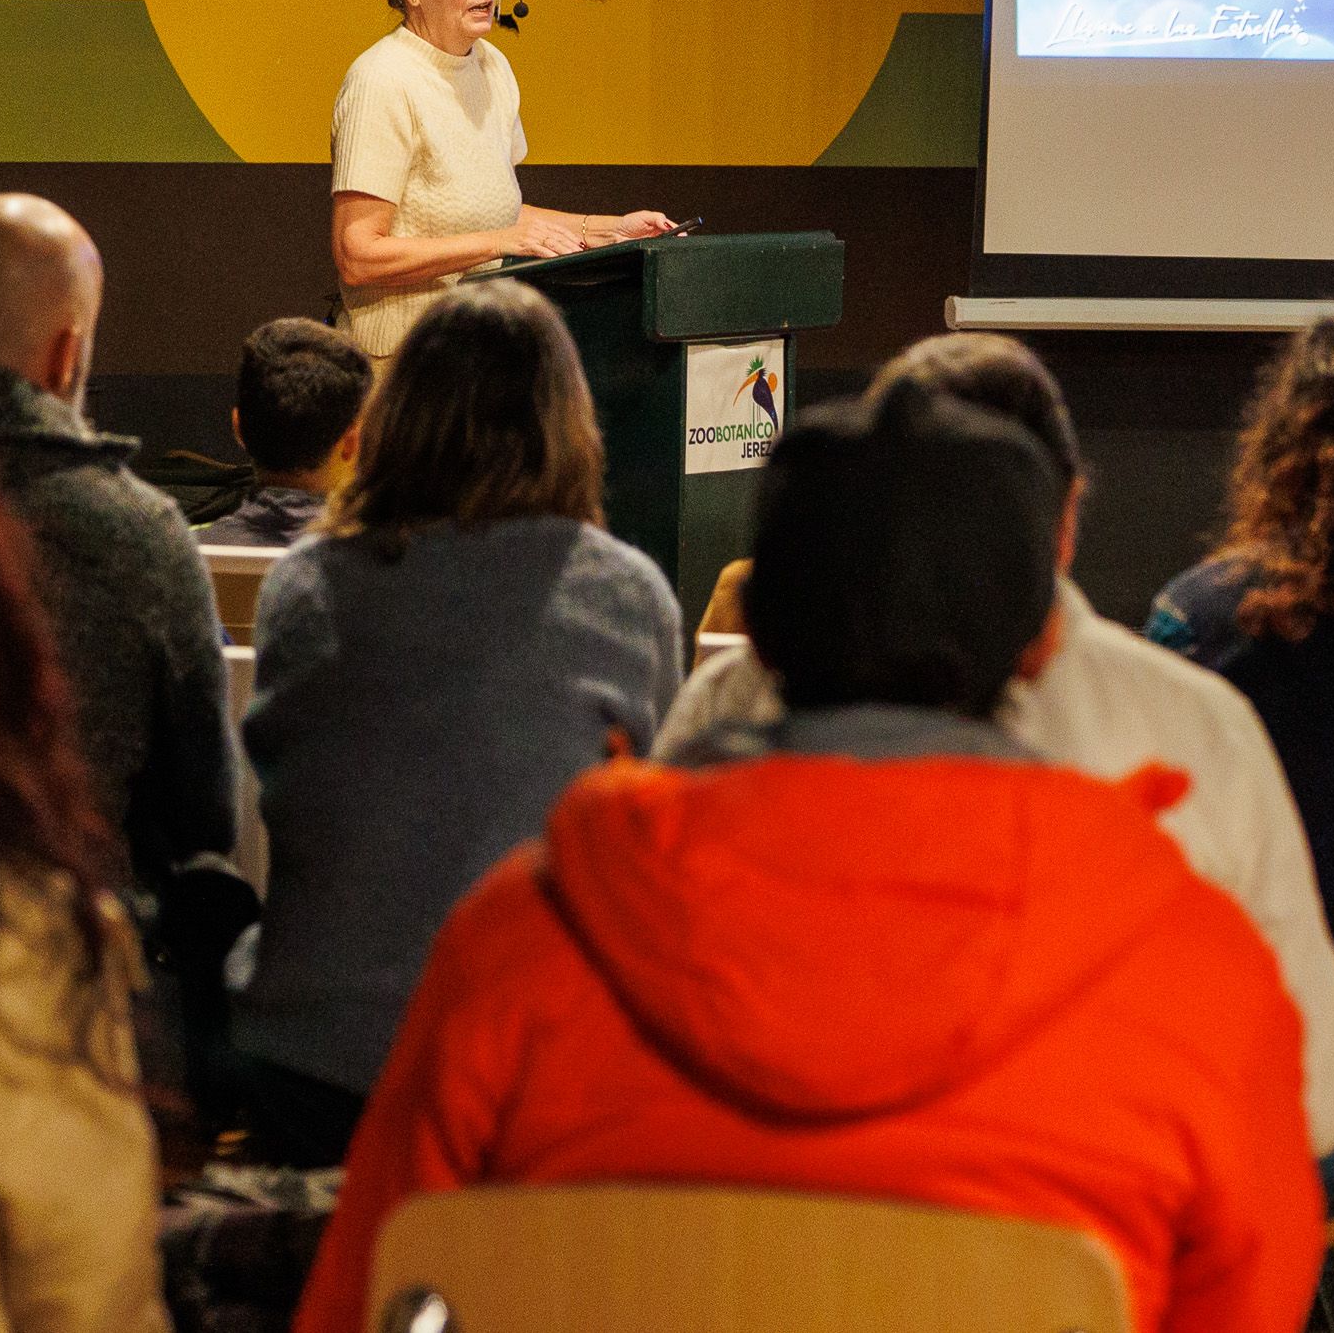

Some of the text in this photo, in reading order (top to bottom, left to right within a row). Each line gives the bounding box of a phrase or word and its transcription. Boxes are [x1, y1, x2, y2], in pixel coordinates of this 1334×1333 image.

[1164, 9, 1199, 38] las
[1209, 3, 1305, 44] Estrellas
[741, 441, 772, 459] JEREZ
